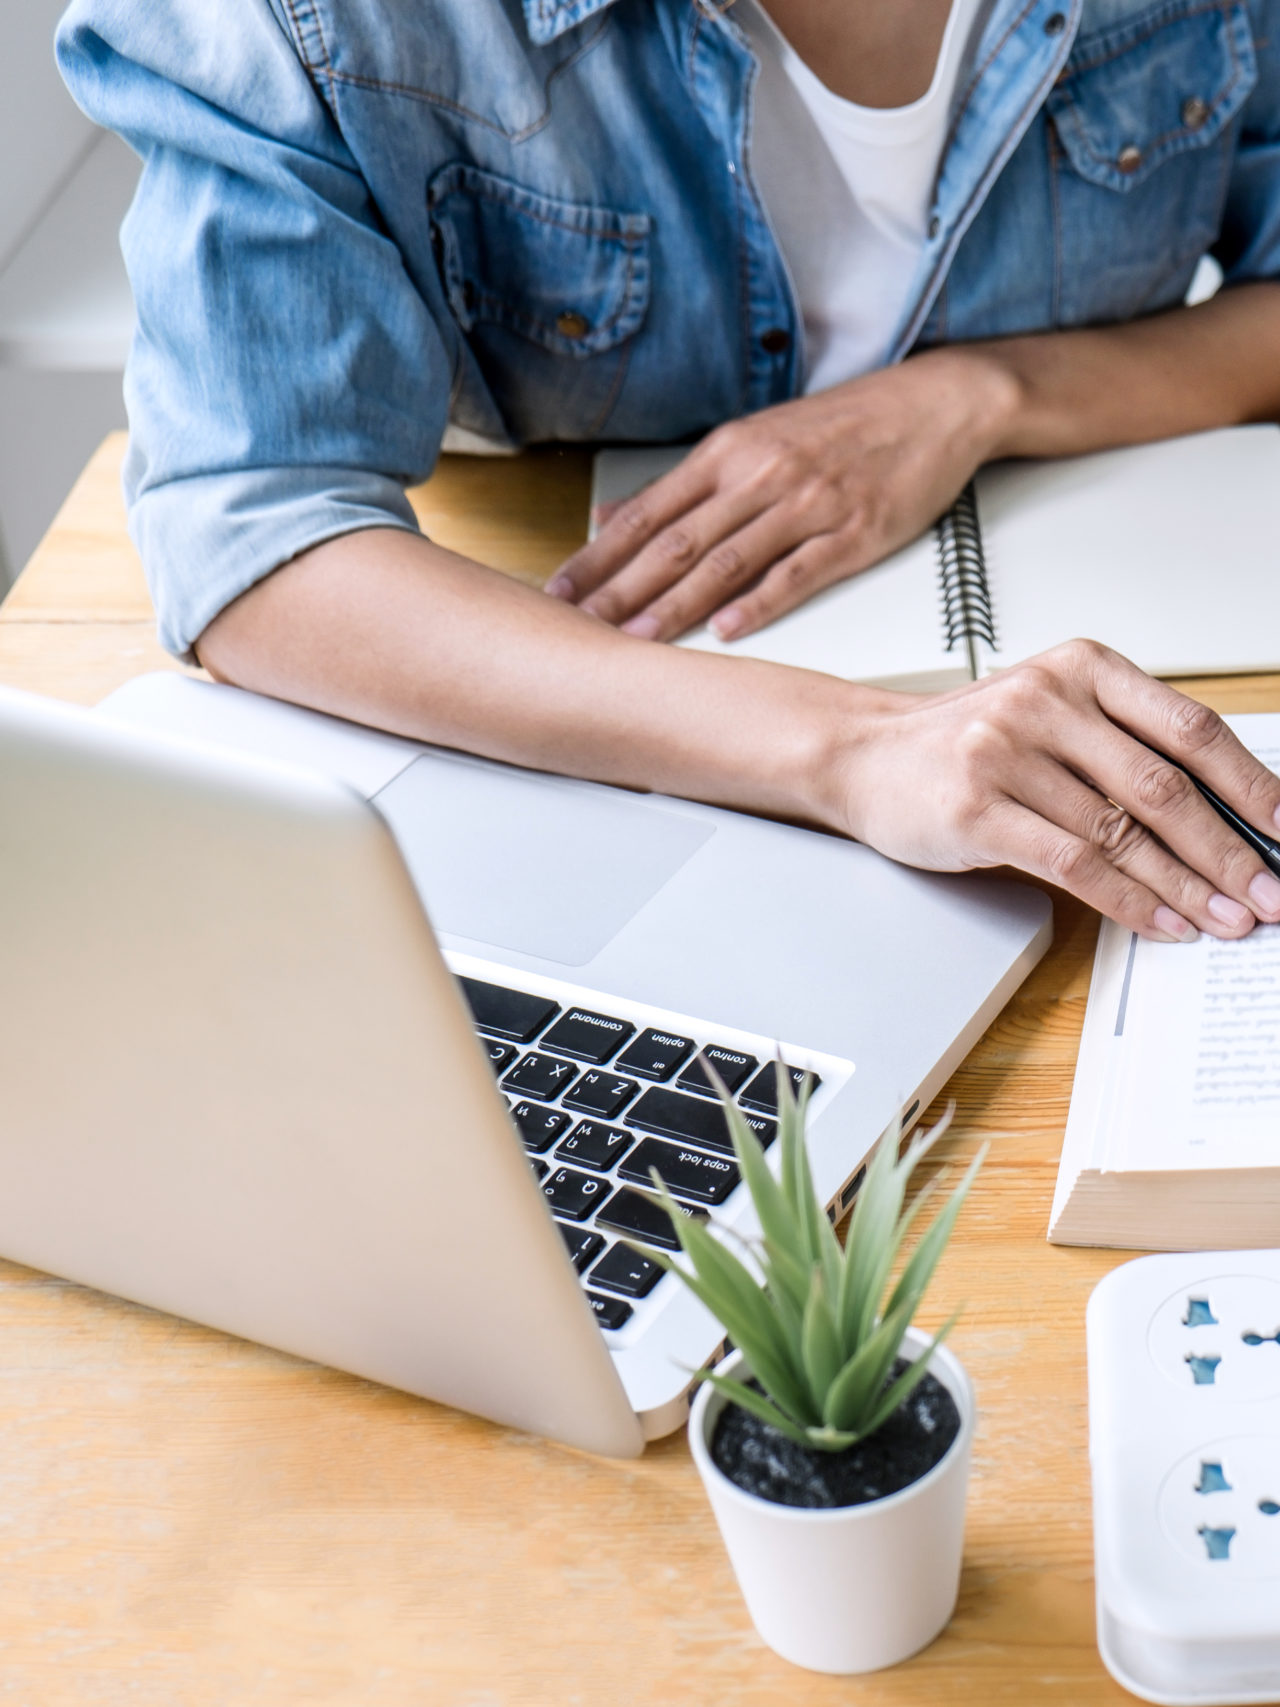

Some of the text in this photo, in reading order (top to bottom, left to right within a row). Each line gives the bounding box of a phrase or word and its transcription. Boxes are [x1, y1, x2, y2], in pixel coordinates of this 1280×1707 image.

[569, 1012, 623, 1032] command
[651, 1033, 685, 1048] option
[489, 1047, 506, 1059] C
[708, 1049, 747, 1065] control
[549, 1064, 568, 1078] X
[652, 1061, 666, 1069] alt
[611, 1081, 629, 1095] Z
[544, 1115, 560, 1128] S
[607, 1132, 623, 1146] A
[678, 1151, 731, 1172] caps lock
[582, 1180, 599, 1194] Q
[581, 1236, 592, 1250] 1
